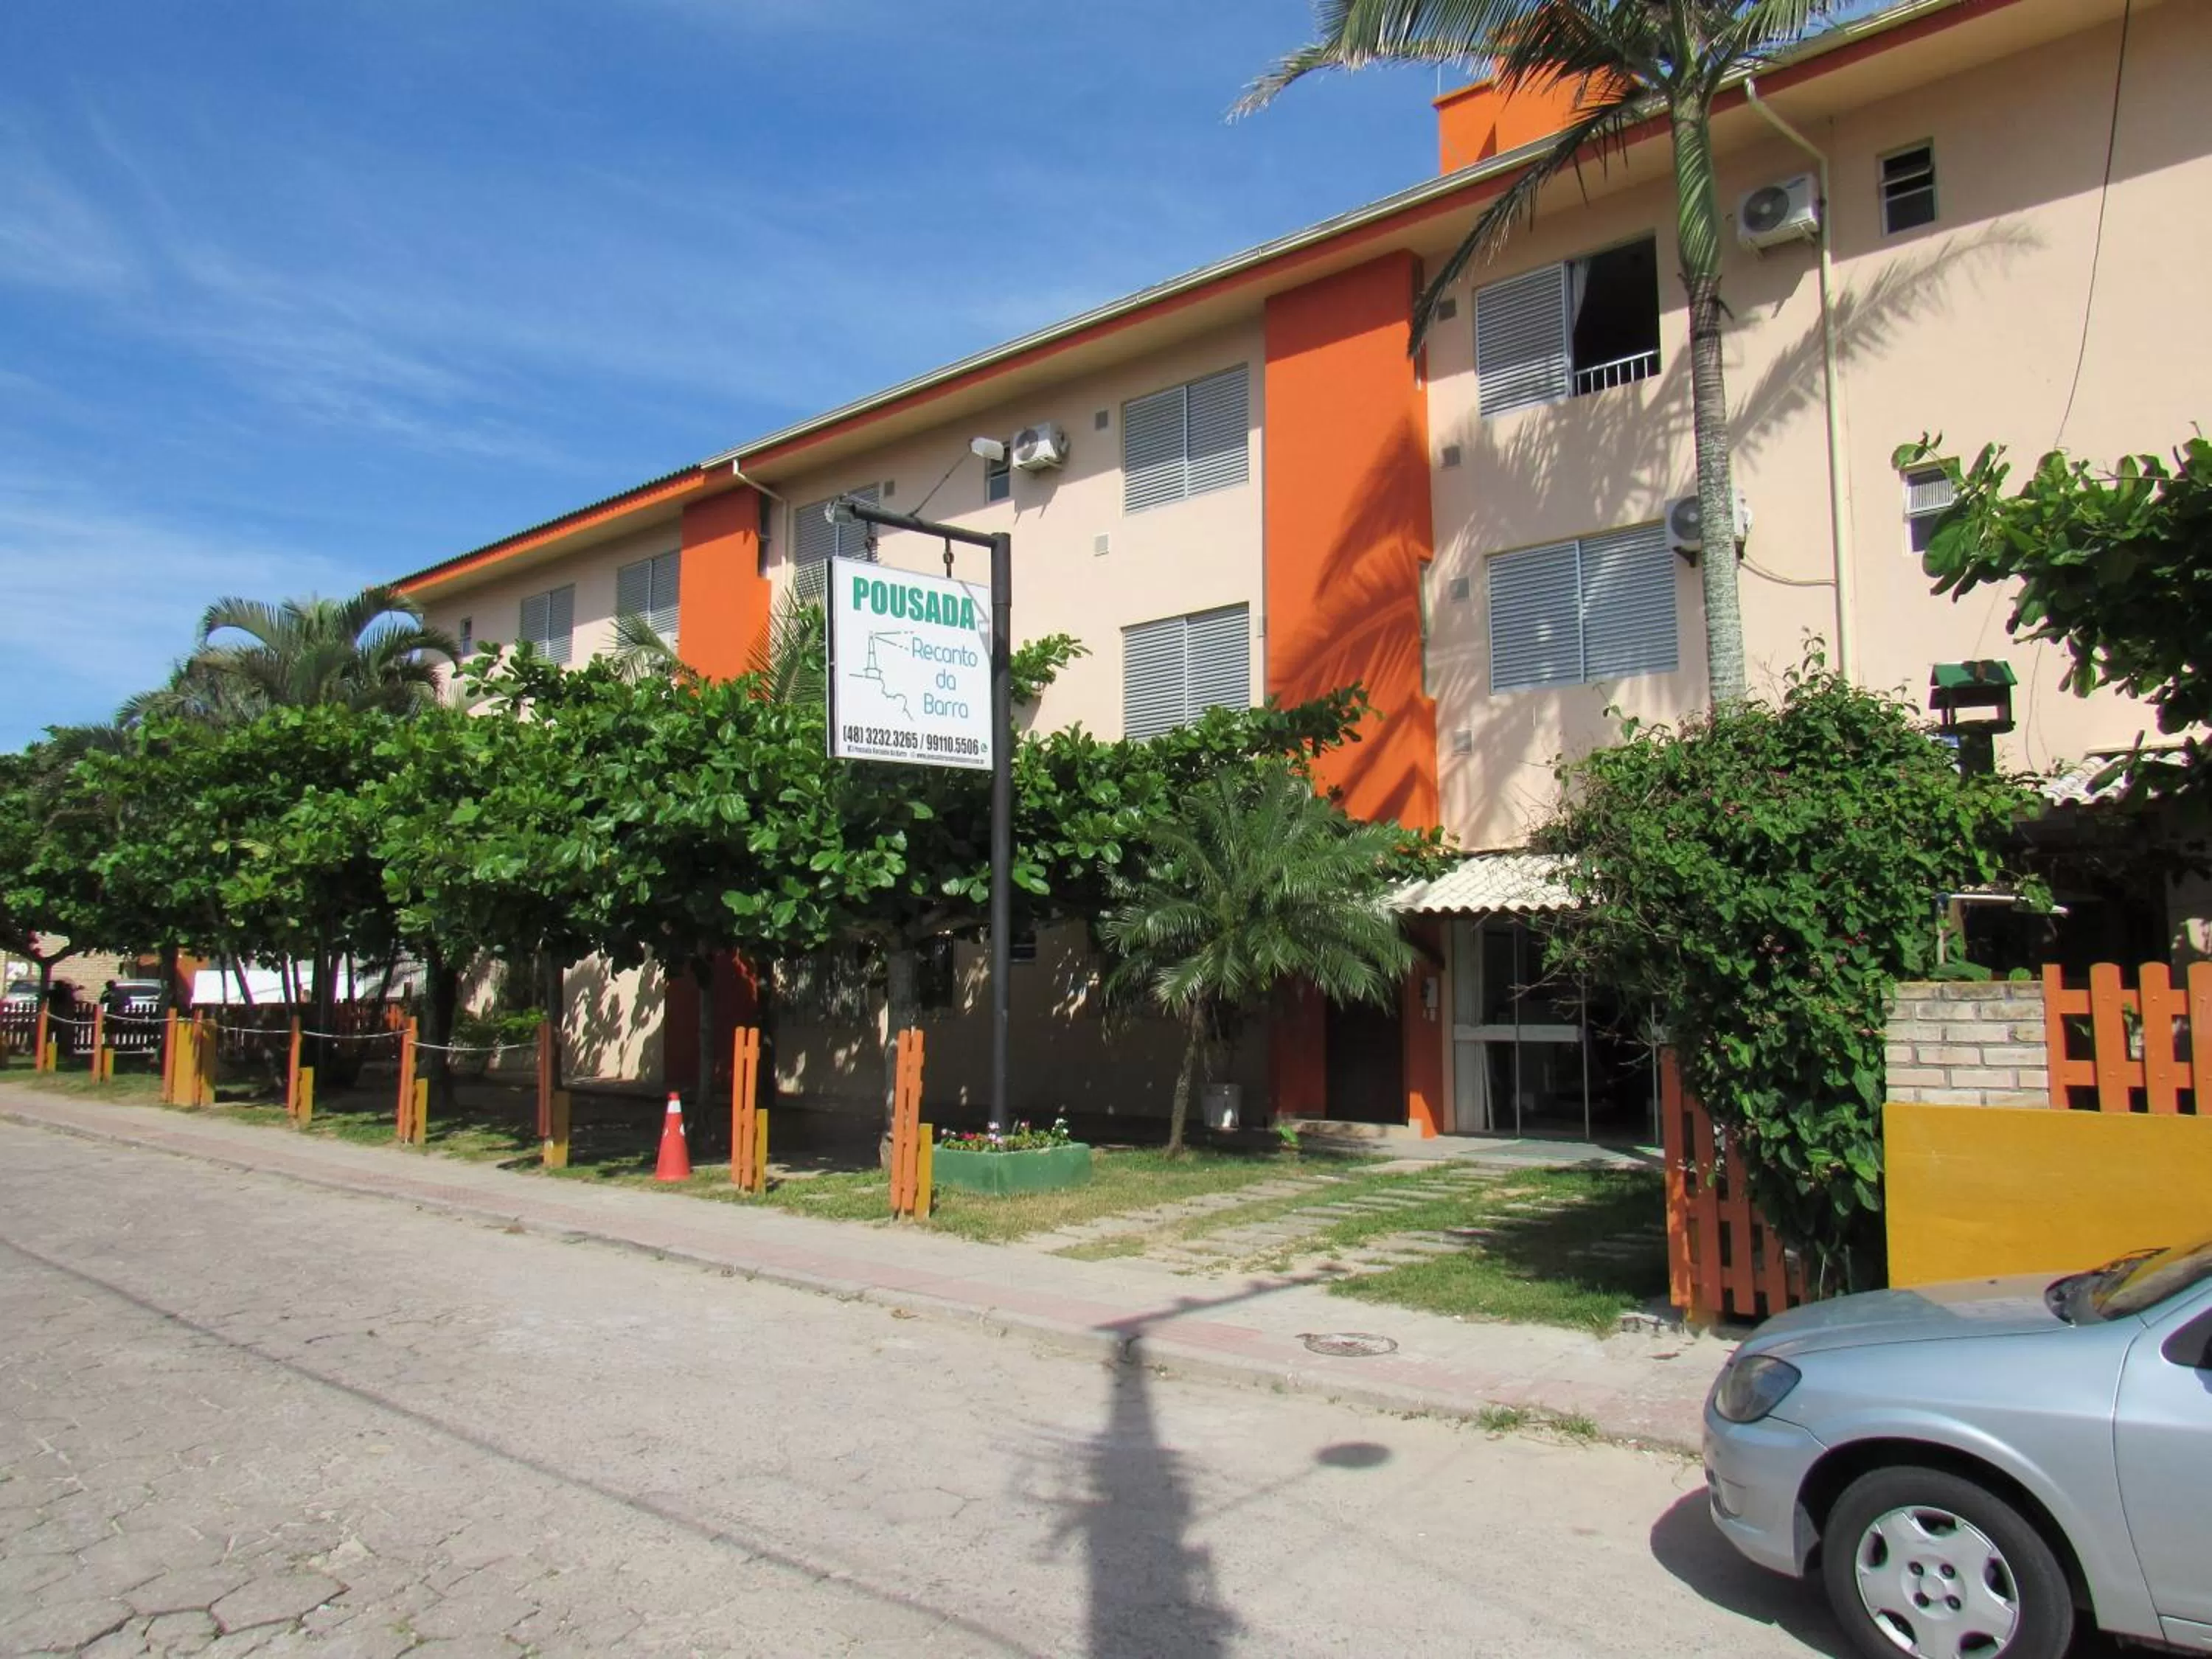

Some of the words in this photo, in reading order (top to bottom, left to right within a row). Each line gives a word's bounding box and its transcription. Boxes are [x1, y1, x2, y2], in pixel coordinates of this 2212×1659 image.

[852, 577, 975, 630] POUSADA
[912, 637, 978, 667] Recanto
[936, 669, 956, 690] da
[924, 693, 968, 719] Barra
[866, 727, 918, 749] 3232.3265
[926, 734, 978, 755] 99110.5506
